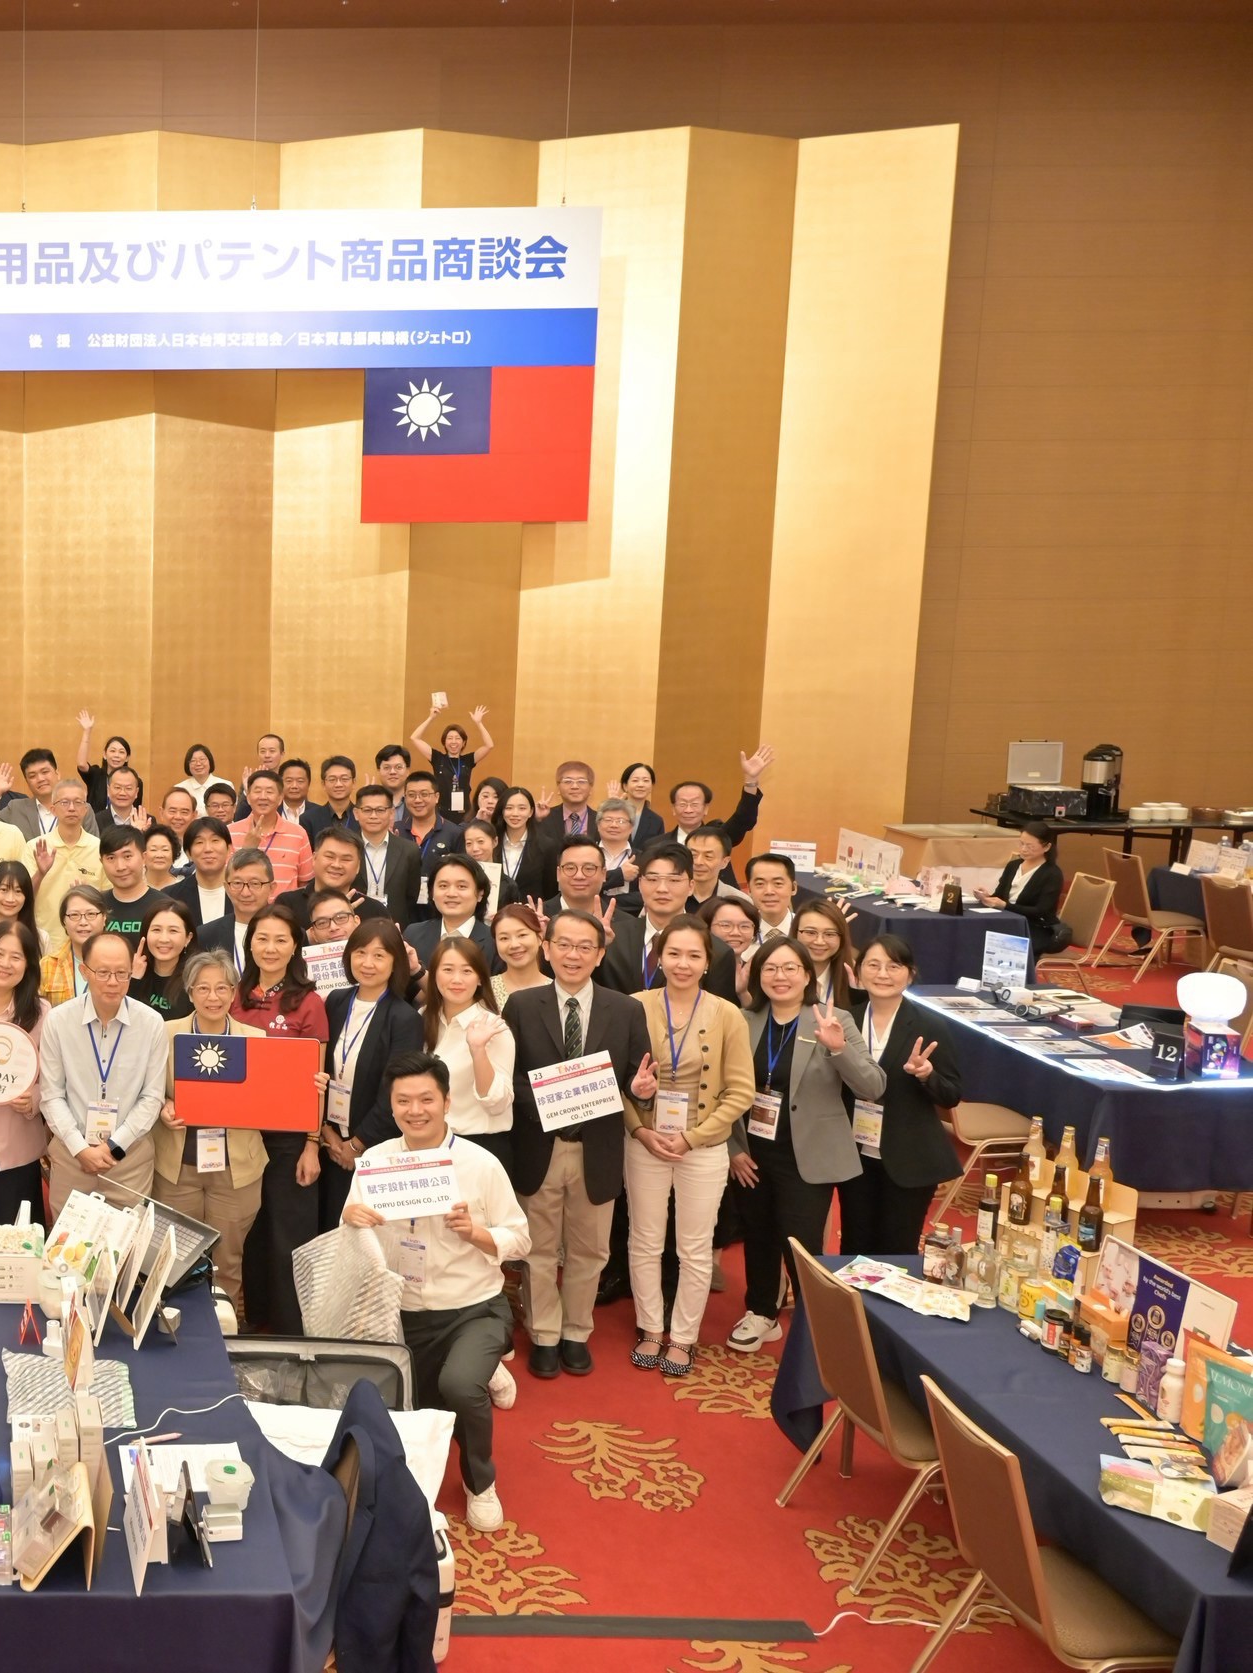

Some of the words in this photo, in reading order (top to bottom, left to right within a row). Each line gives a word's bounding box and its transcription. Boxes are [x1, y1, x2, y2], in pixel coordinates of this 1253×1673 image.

[946, 892, 954, 903] 2
[313, 969, 346, 981] 股份有限
[1155, 1044, 1178, 1062] 12
[533, 1072, 543, 1081] 23
[360, 1160, 371, 1168] 20
[396, 1199, 422, 1207] DESIGN
